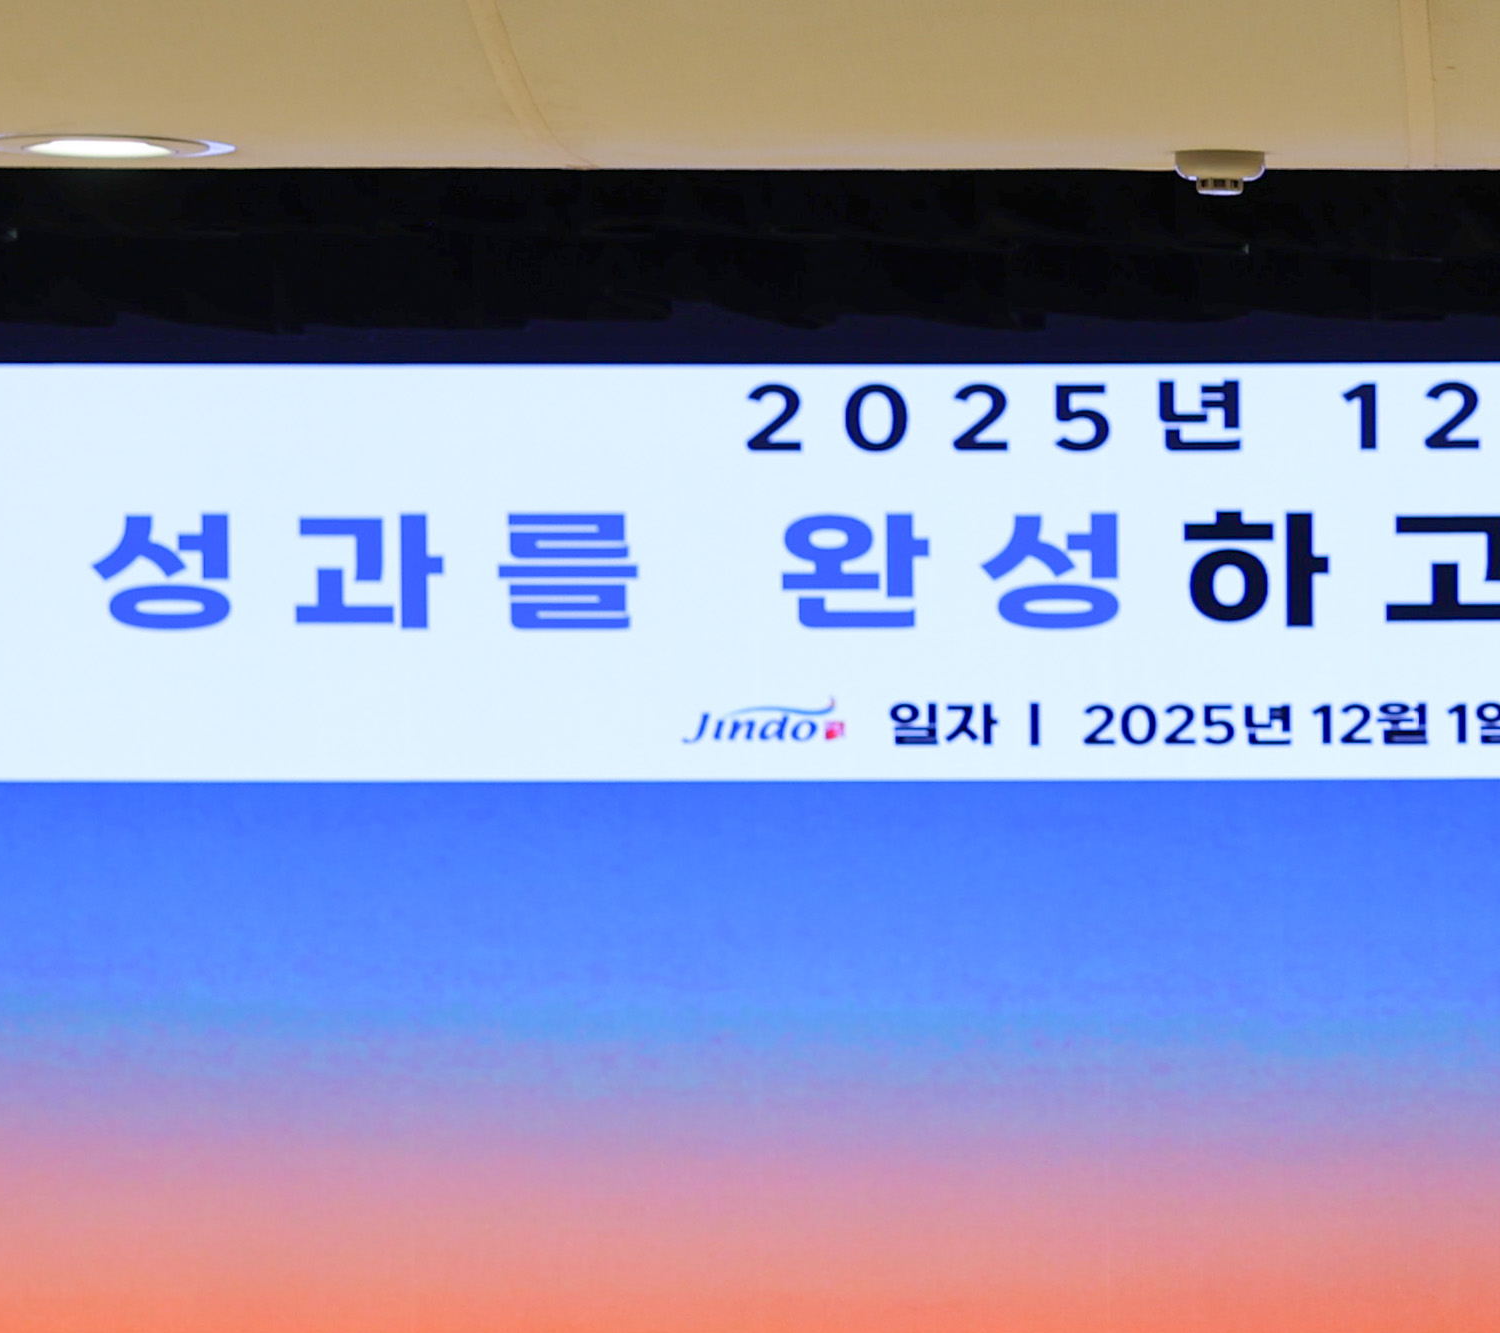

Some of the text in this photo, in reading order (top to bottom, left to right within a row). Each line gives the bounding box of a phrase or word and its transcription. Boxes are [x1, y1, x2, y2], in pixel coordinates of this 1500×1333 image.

[747, 377, 1242, 453] 2025년
[92, 513, 638, 630] 성과를
[889, 702, 999, 747] 일자
[1083, 703, 1292, 747] 2025년
[1312, 702, 1429, 747] 12월
